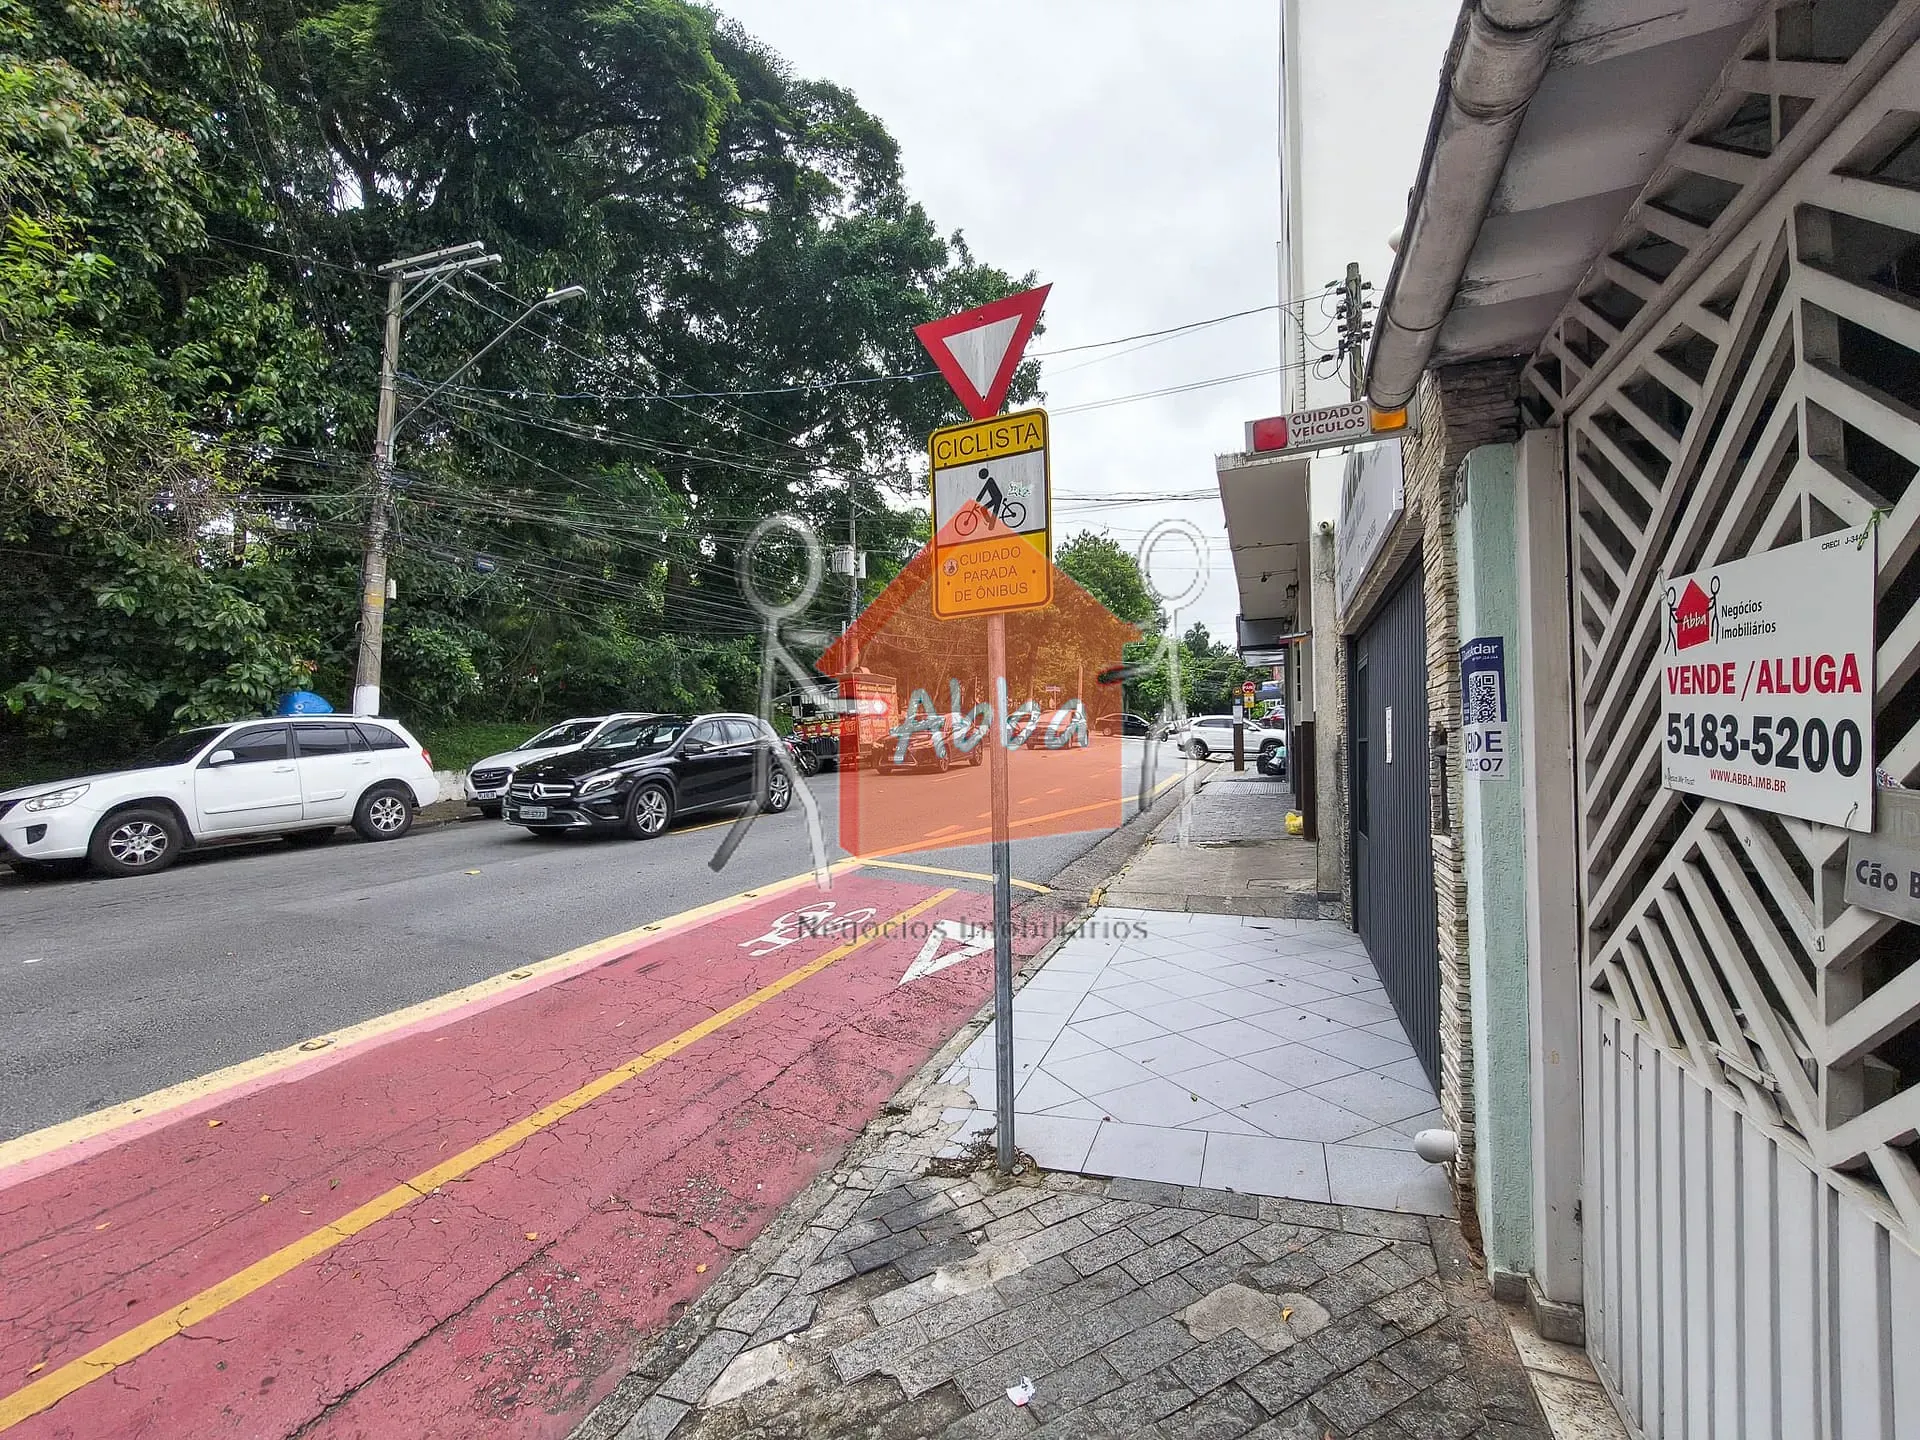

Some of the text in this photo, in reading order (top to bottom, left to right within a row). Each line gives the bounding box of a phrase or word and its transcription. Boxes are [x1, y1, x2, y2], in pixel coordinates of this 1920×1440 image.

[1292, 405, 1362, 426] CUIDADO
[1291, 416, 1365, 438] VEÍCULOS
[936, 422, 1040, 460] CICLISTA
[959, 546, 1021, 566] CUIDADO
[963, 565, 1018, 583] PARADA
[954, 582, 1028, 603] DE ÔNIBUS
[1721, 600, 1763, 620] Negócios
[1682, 611, 1707, 632] Abba
[1721, 620, 1777, 640] Imobiliários
[1667, 662, 1736, 695] VENDE
[1667, 712, 1862, 778] 5183-5200
[1710, 768, 1787, 793] WWW.ABBA.IMB.BR
[1855, 860, 1898, 892] Cão
